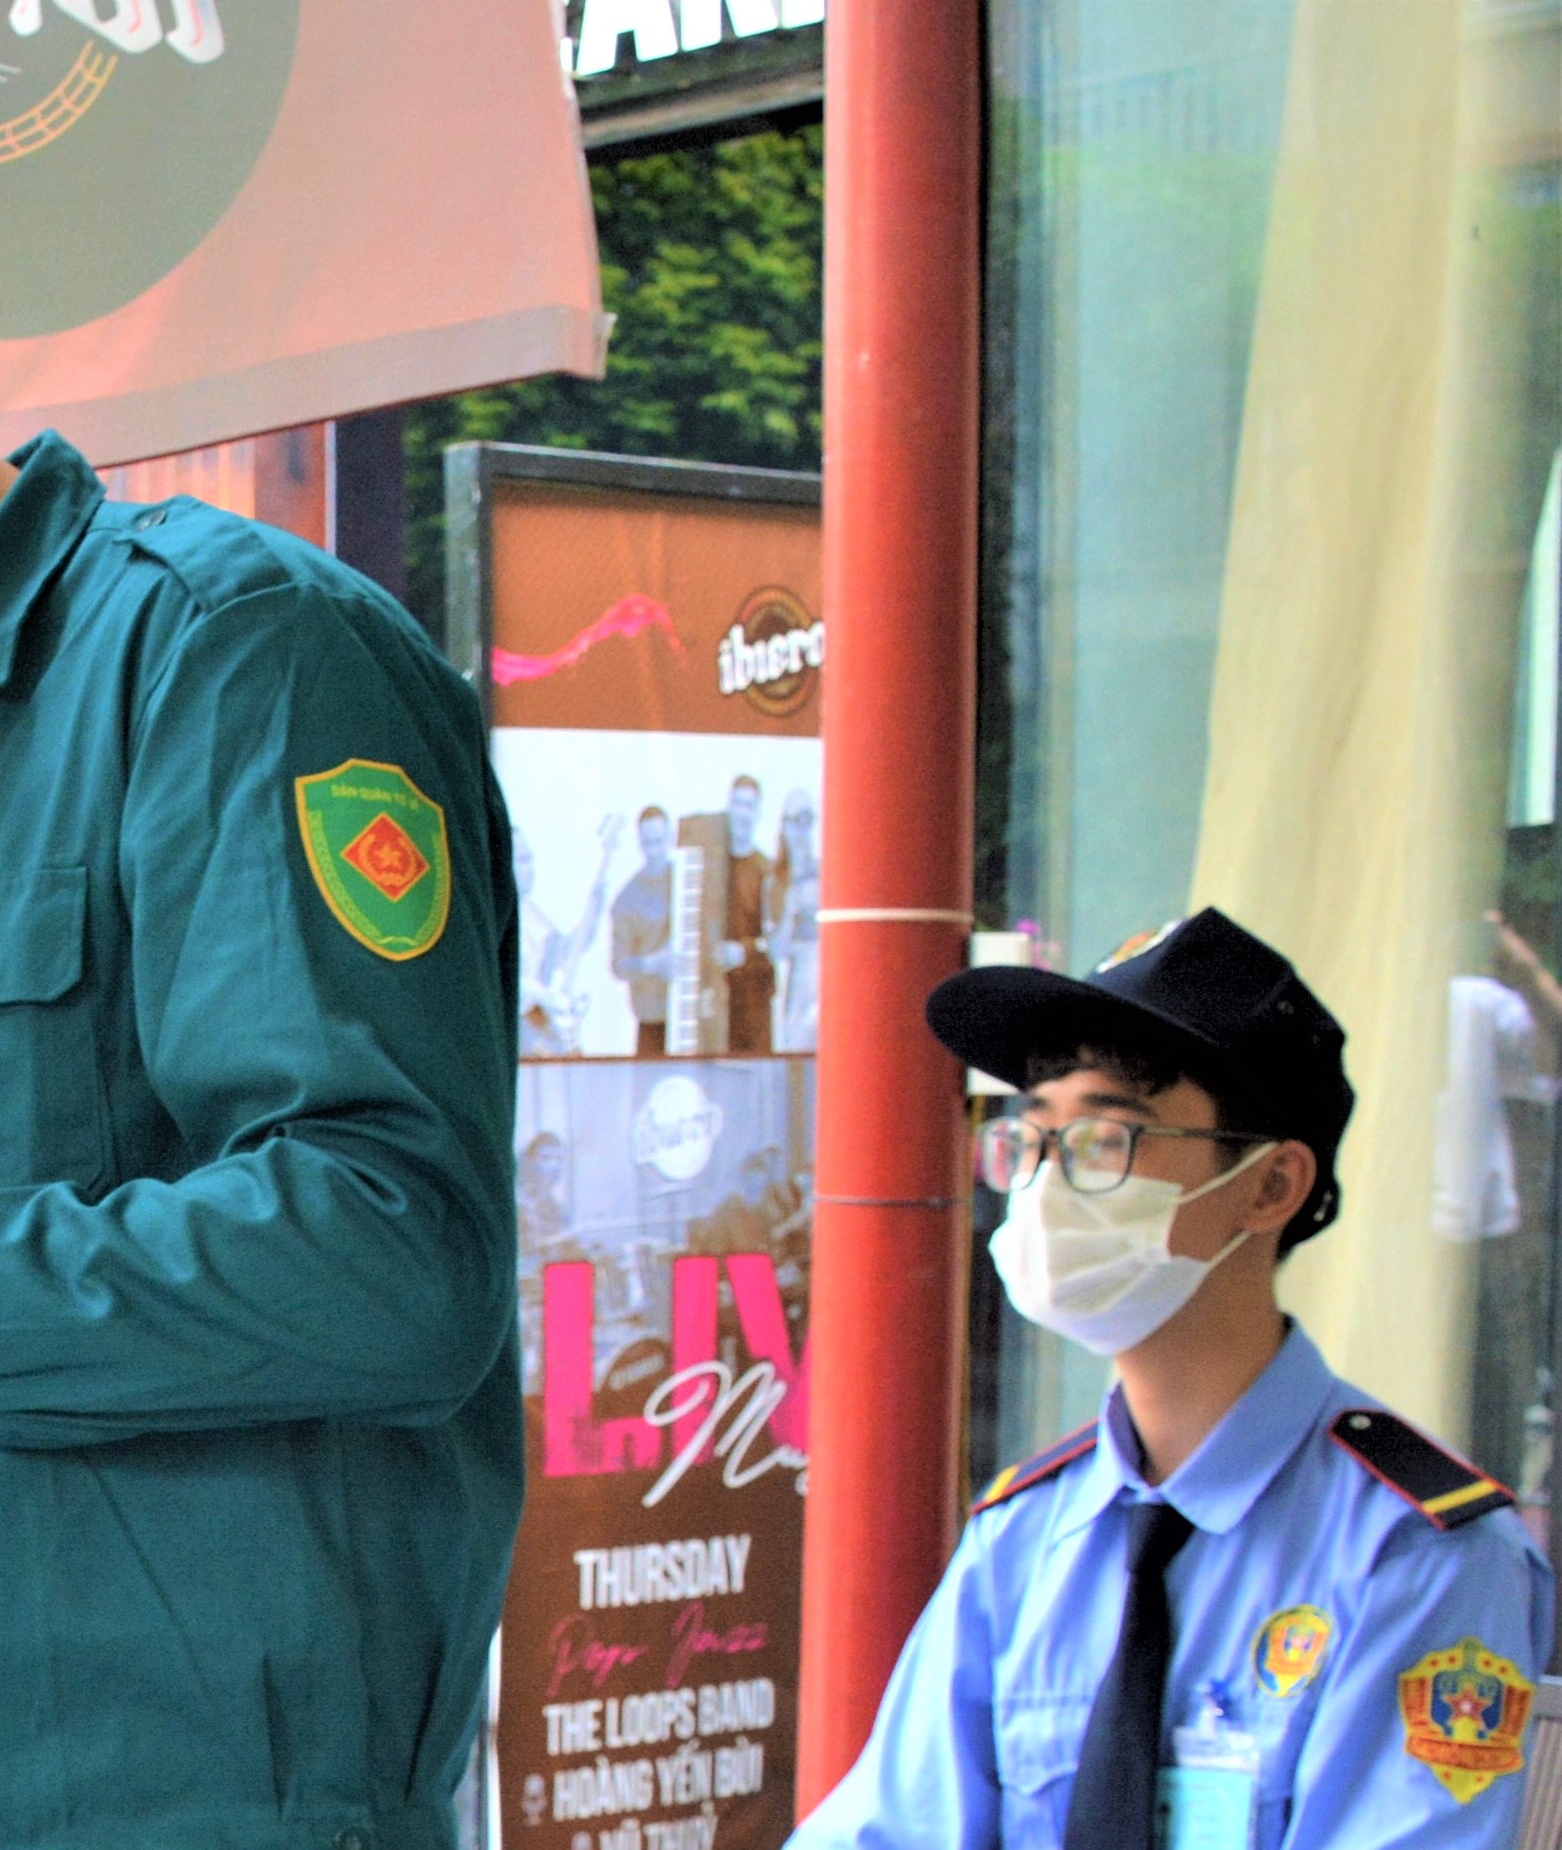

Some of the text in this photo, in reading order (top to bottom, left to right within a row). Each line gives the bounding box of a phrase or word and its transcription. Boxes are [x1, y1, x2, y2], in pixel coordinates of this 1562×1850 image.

[544, 1253, 812, 1478] LIV
[574, 1533, 751, 1610] THURSDAY
[542, 1677, 776, 1757] THE LOOPS BAND
